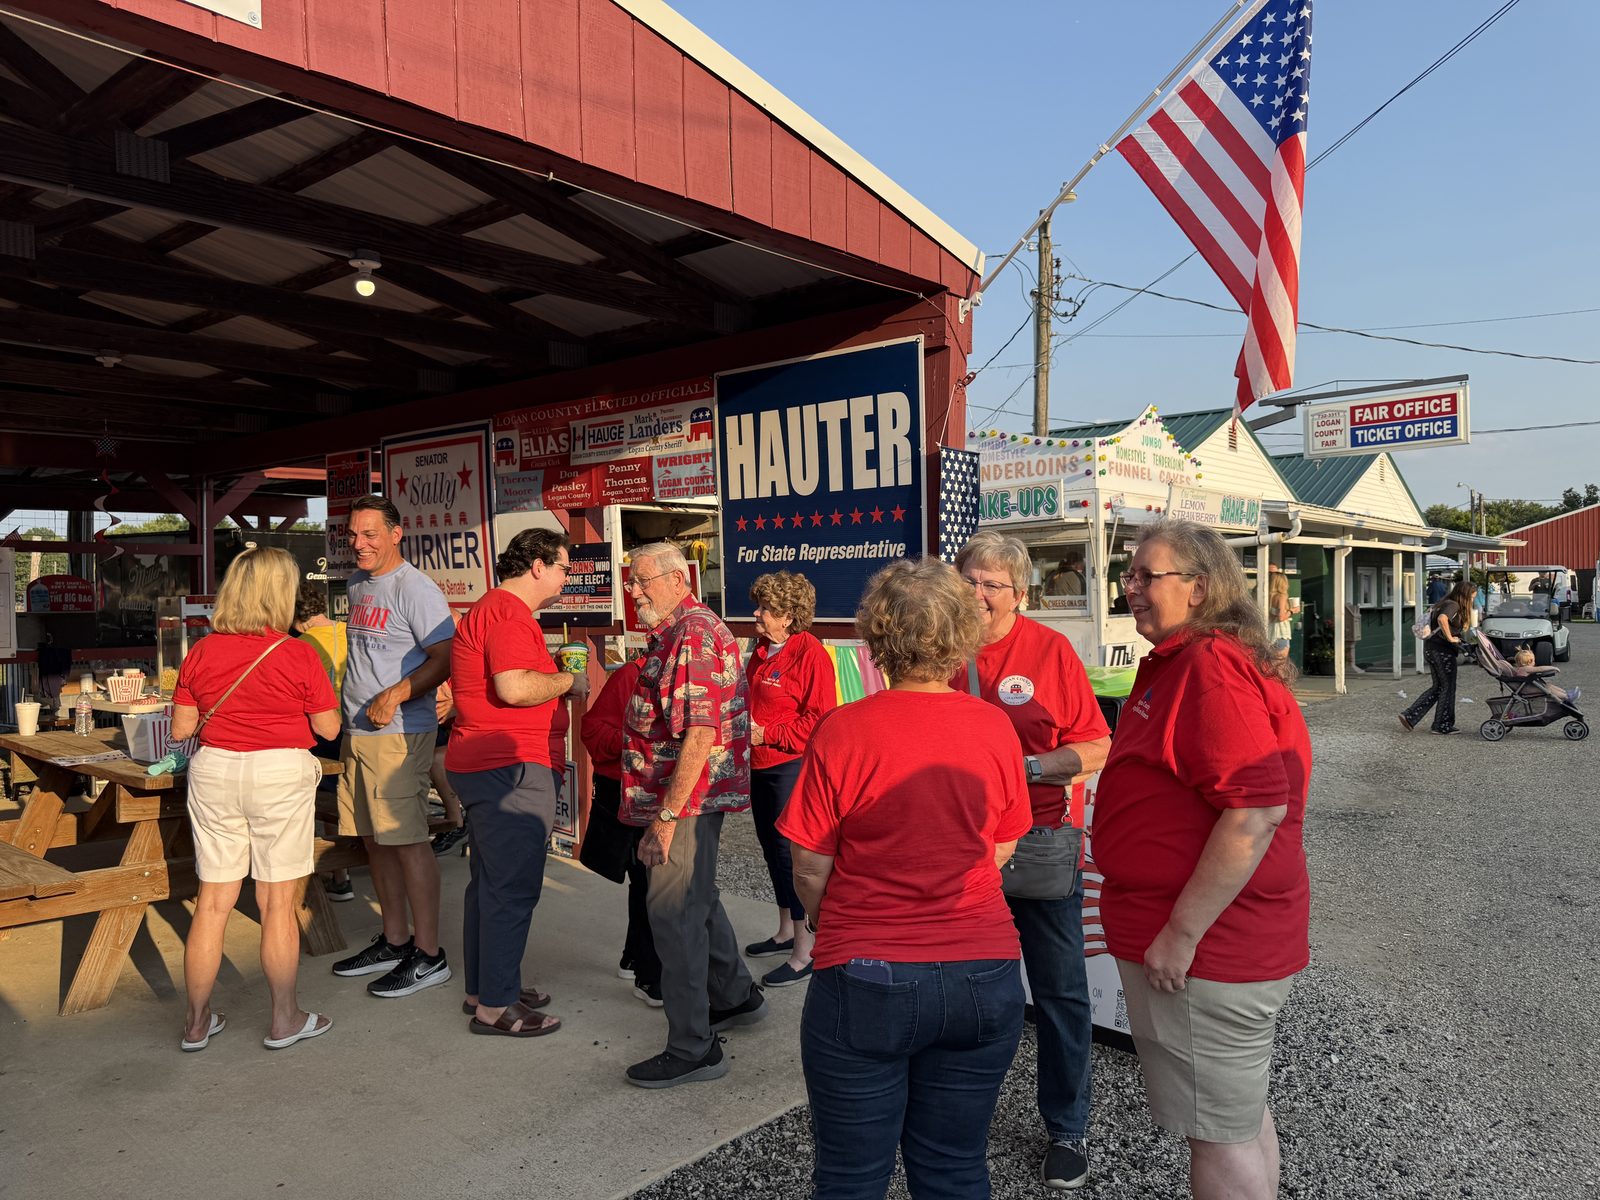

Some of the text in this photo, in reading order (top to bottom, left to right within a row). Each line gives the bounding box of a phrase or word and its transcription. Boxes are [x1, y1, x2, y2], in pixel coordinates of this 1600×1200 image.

[496, 381, 711, 426] LOGAN COUNTY ELECTED OFFICIALS
[1354, 397, 1452, 422] FAIR OFFICE
[634, 413, 653, 425] Mark
[1316, 418, 1341, 427] LOGAN
[588, 424, 625, 444] HAUGE
[628, 418, 683, 439] Landers
[1314, 429, 1344, 437] COUNTY
[1355, 420, 1452, 443] TICKET OFFICE
[521, 432, 570, 457] ELIAS
[628, 440, 684, 455] Logan County Sheriff
[725, 391, 913, 500] HAUTER
[977, 440, 1008, 452] JUMBO
[1141, 435, 1163, 450] JUMBO
[415, 453, 448, 467] SENATOR
[656, 452, 713, 469] WRIGHT
[979, 447, 1027, 462] OMESTYLE
[1115, 446, 1185, 472] HOMESTYLE TENDERLOINS
[560, 470, 579, 479] Don
[608, 463, 642, 474] Penny
[980, 455, 1080, 482] NDERLOINS
[1108, 461, 1192, 486] FUNNEL CAKES
[328, 464, 369, 498] Fioretti
[501, 475, 538, 485] Theresa
[551, 481, 587, 493] Peasley
[604, 476, 647, 488] Thomas
[657, 474, 716, 488] LOGAN COUNTY
[409, 471, 458, 511] Sally
[503, 488, 533, 497] Moore
[547, 492, 592, 502] Logan County
[624, 486, 651, 495] County
[660, 485, 716, 498] CIRCUIT JUDGE
[610, 496, 643, 504] Treasurer
[1180, 499, 1206, 511] LEMON
[1171, 510, 1219, 524] STRAWBERRY
[1220, 494, 1260, 527] SHAKE-UPS
[737, 539, 906, 564] For State Representative
[595, 560, 610, 572] WHO
[446, 578, 467, 595] Senate
[584, 574, 605, 585] ELECT
[561, 585, 596, 594] EMOCRATS
[64, 593, 77, 603] BIG
[79, 594, 93, 602] BAG
